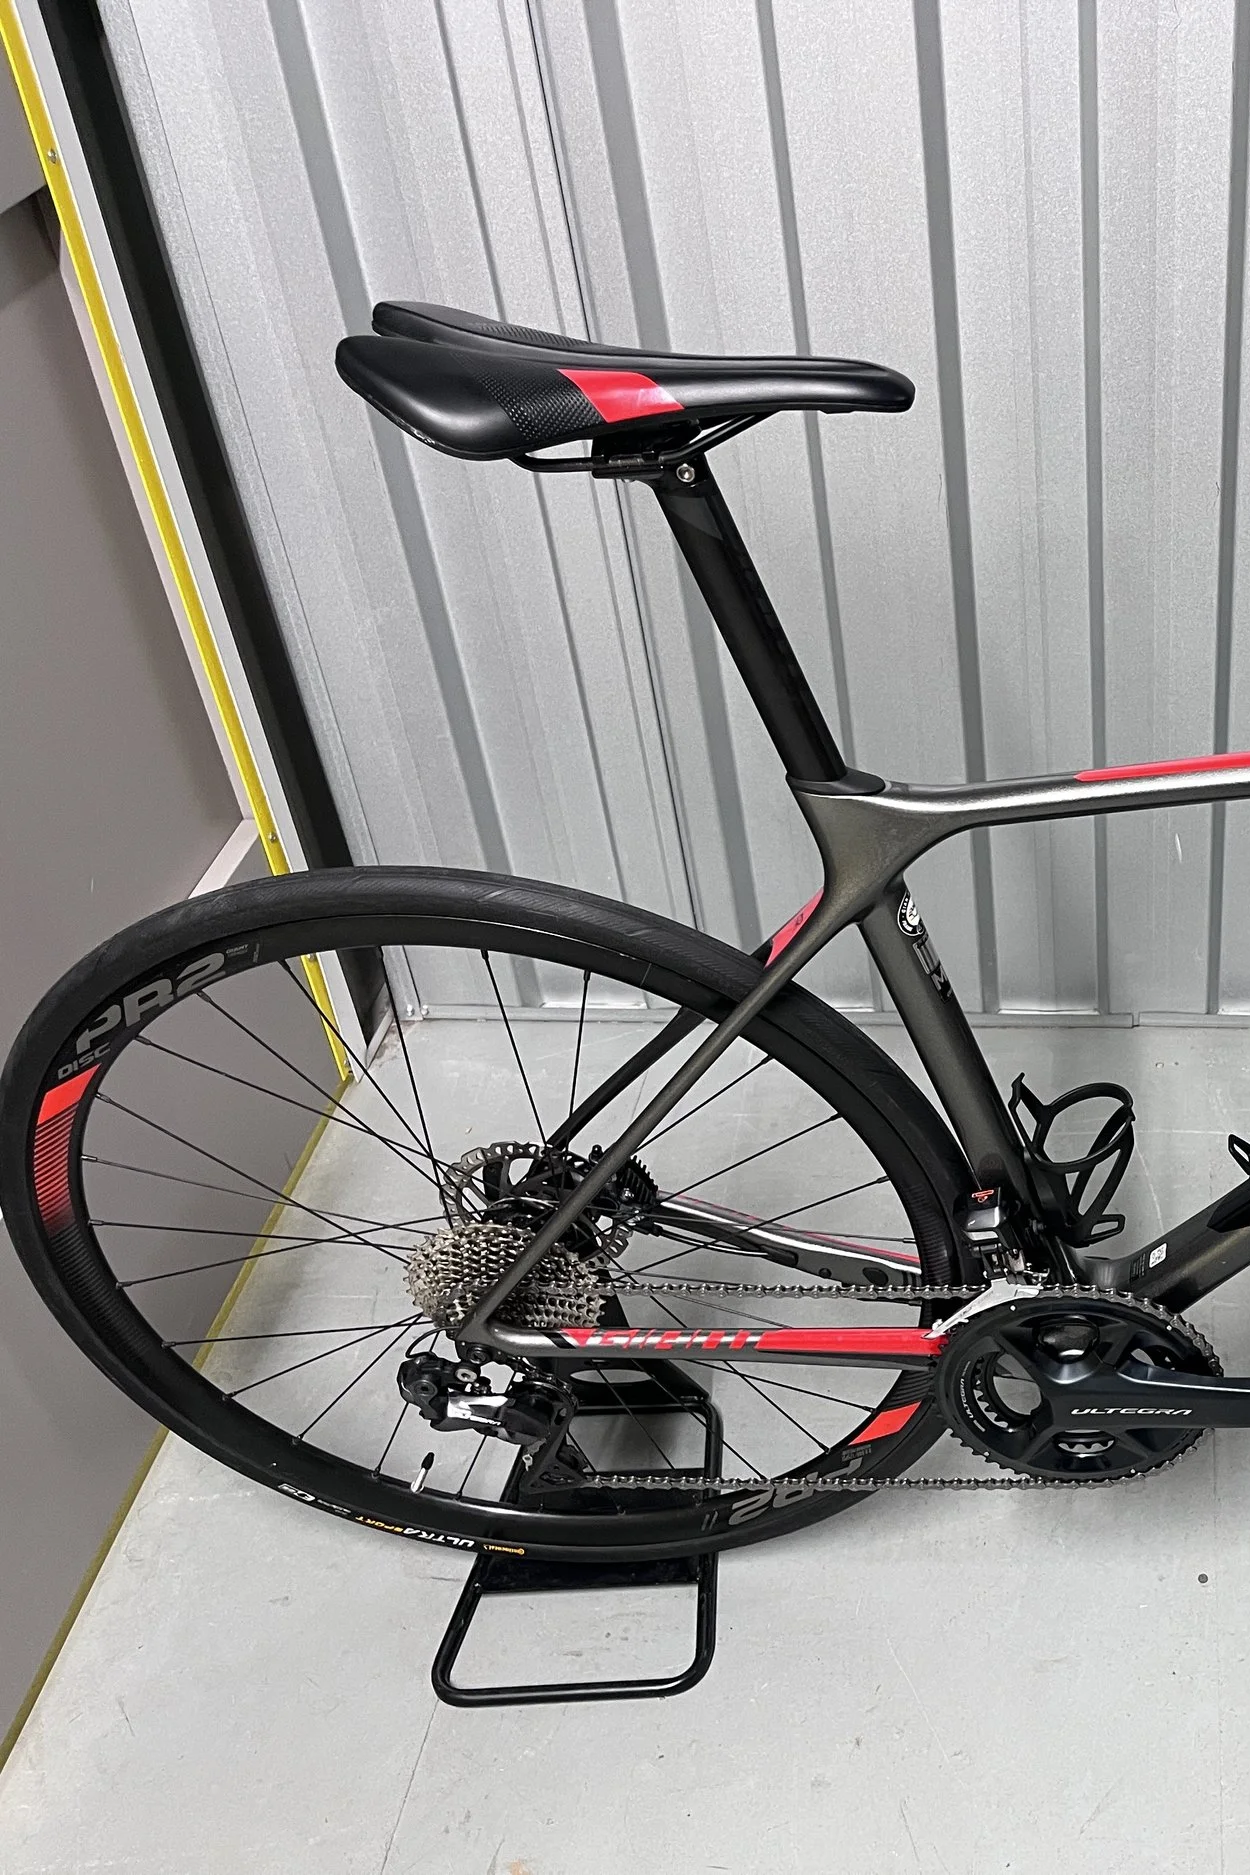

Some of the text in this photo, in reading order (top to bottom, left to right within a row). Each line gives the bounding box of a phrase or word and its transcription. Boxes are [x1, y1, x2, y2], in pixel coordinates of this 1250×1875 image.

[76, 952, 226, 1056] PR2
[57, 1041, 111, 1081] DISC
[1070, 1407, 1193, 1416] ULTEGRA
